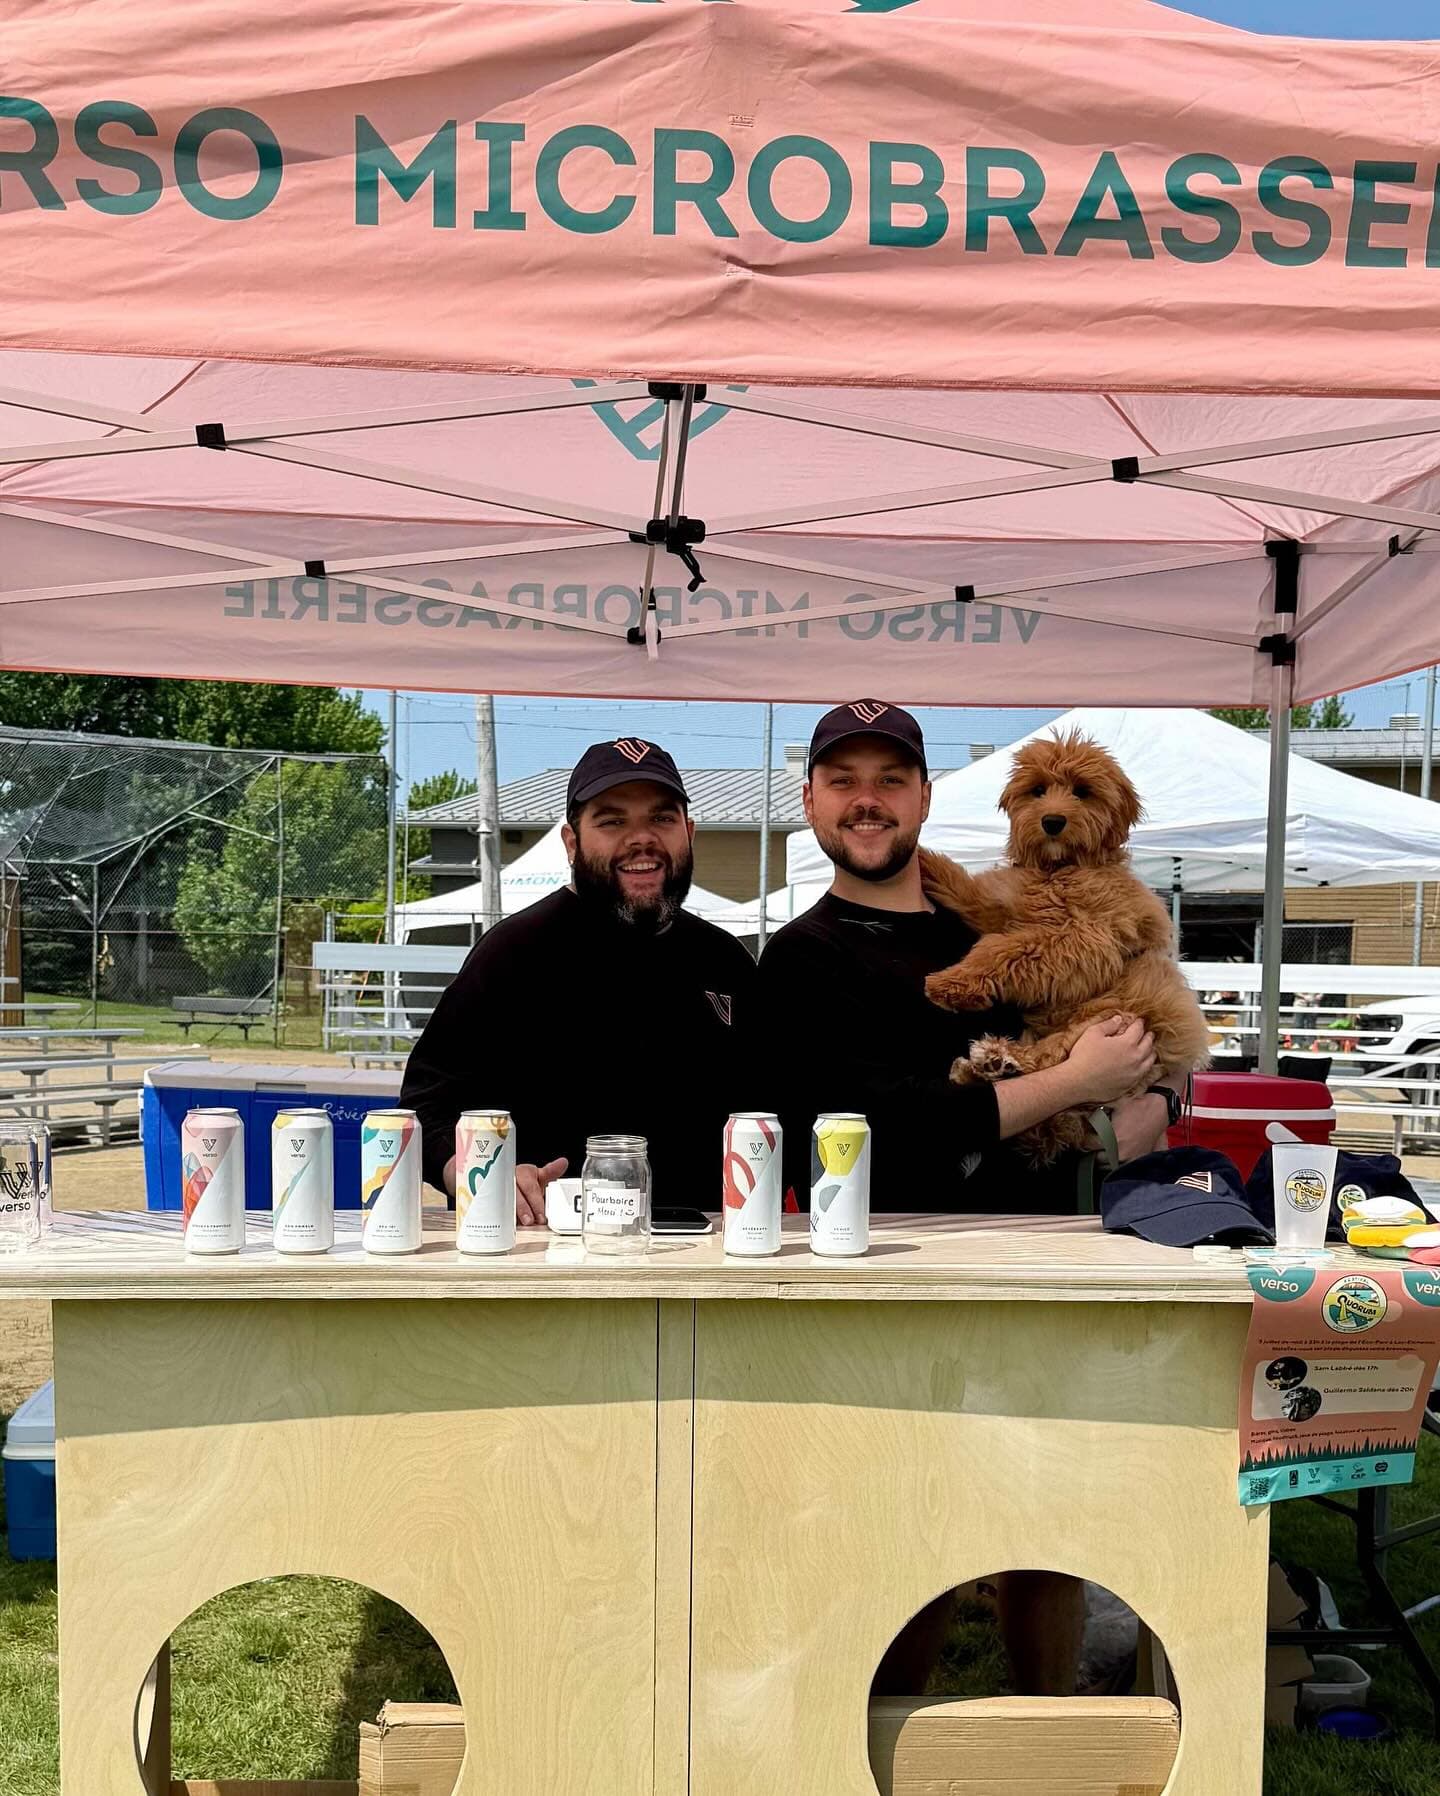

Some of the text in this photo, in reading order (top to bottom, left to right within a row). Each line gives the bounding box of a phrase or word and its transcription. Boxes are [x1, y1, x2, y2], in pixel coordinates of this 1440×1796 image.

[354, 114, 1440, 270] MICROBRASSE
[592, 1192, 635, 1207] Pourboire
[1259, 1277, 1300, 1294] verso
[1337, 1294, 1377, 1315] QUORUM
